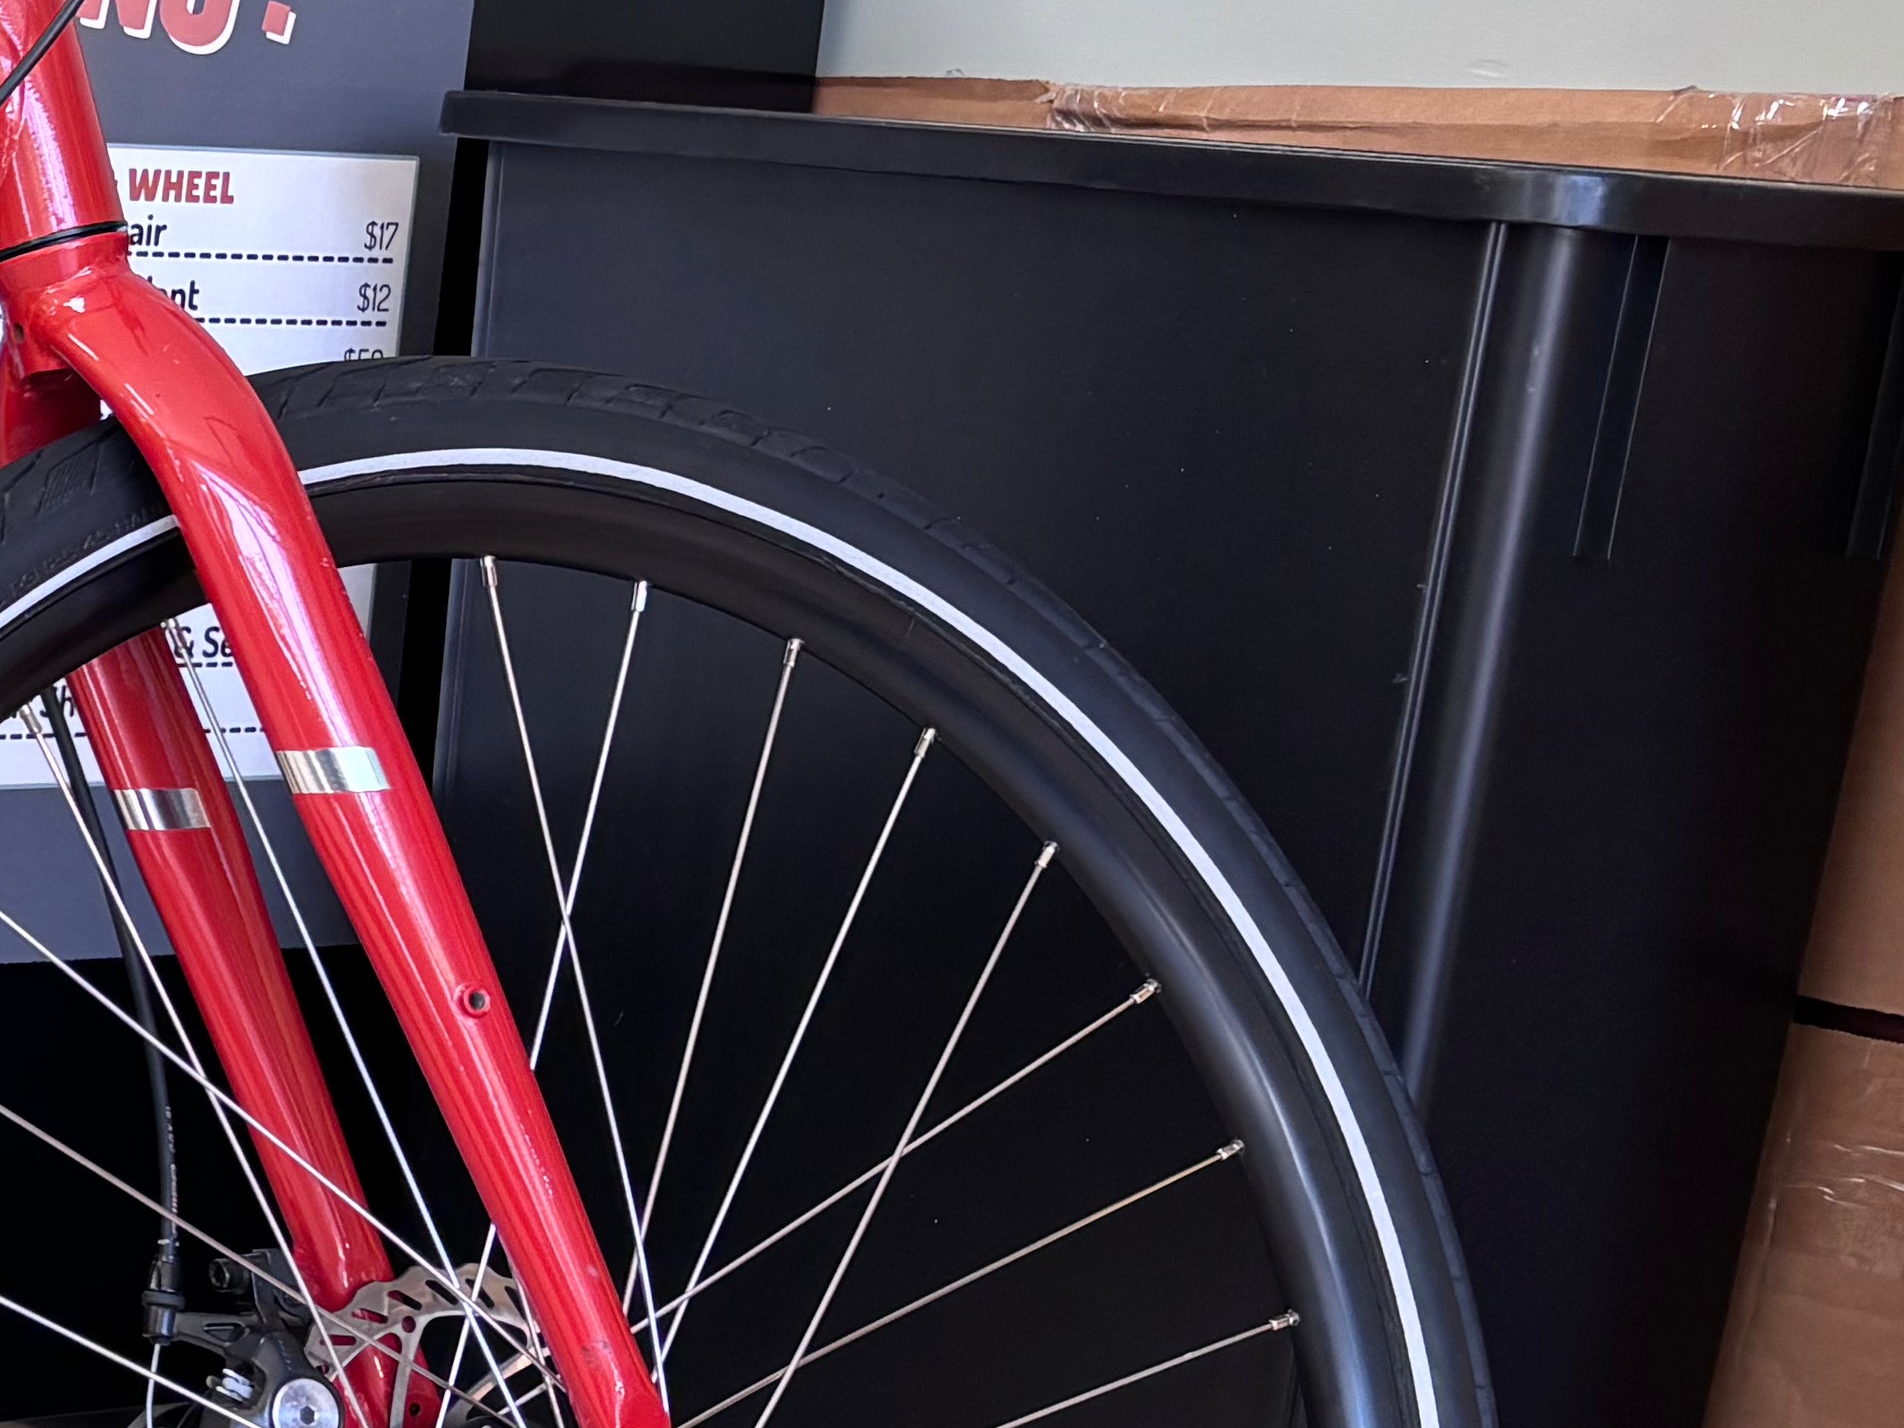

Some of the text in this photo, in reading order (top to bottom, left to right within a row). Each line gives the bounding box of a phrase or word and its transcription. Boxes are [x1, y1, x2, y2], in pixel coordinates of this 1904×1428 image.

[129, 168, 234, 204] WHEEL
[364, 221, 399, 251] $17
[357, 282, 391, 313] $12
